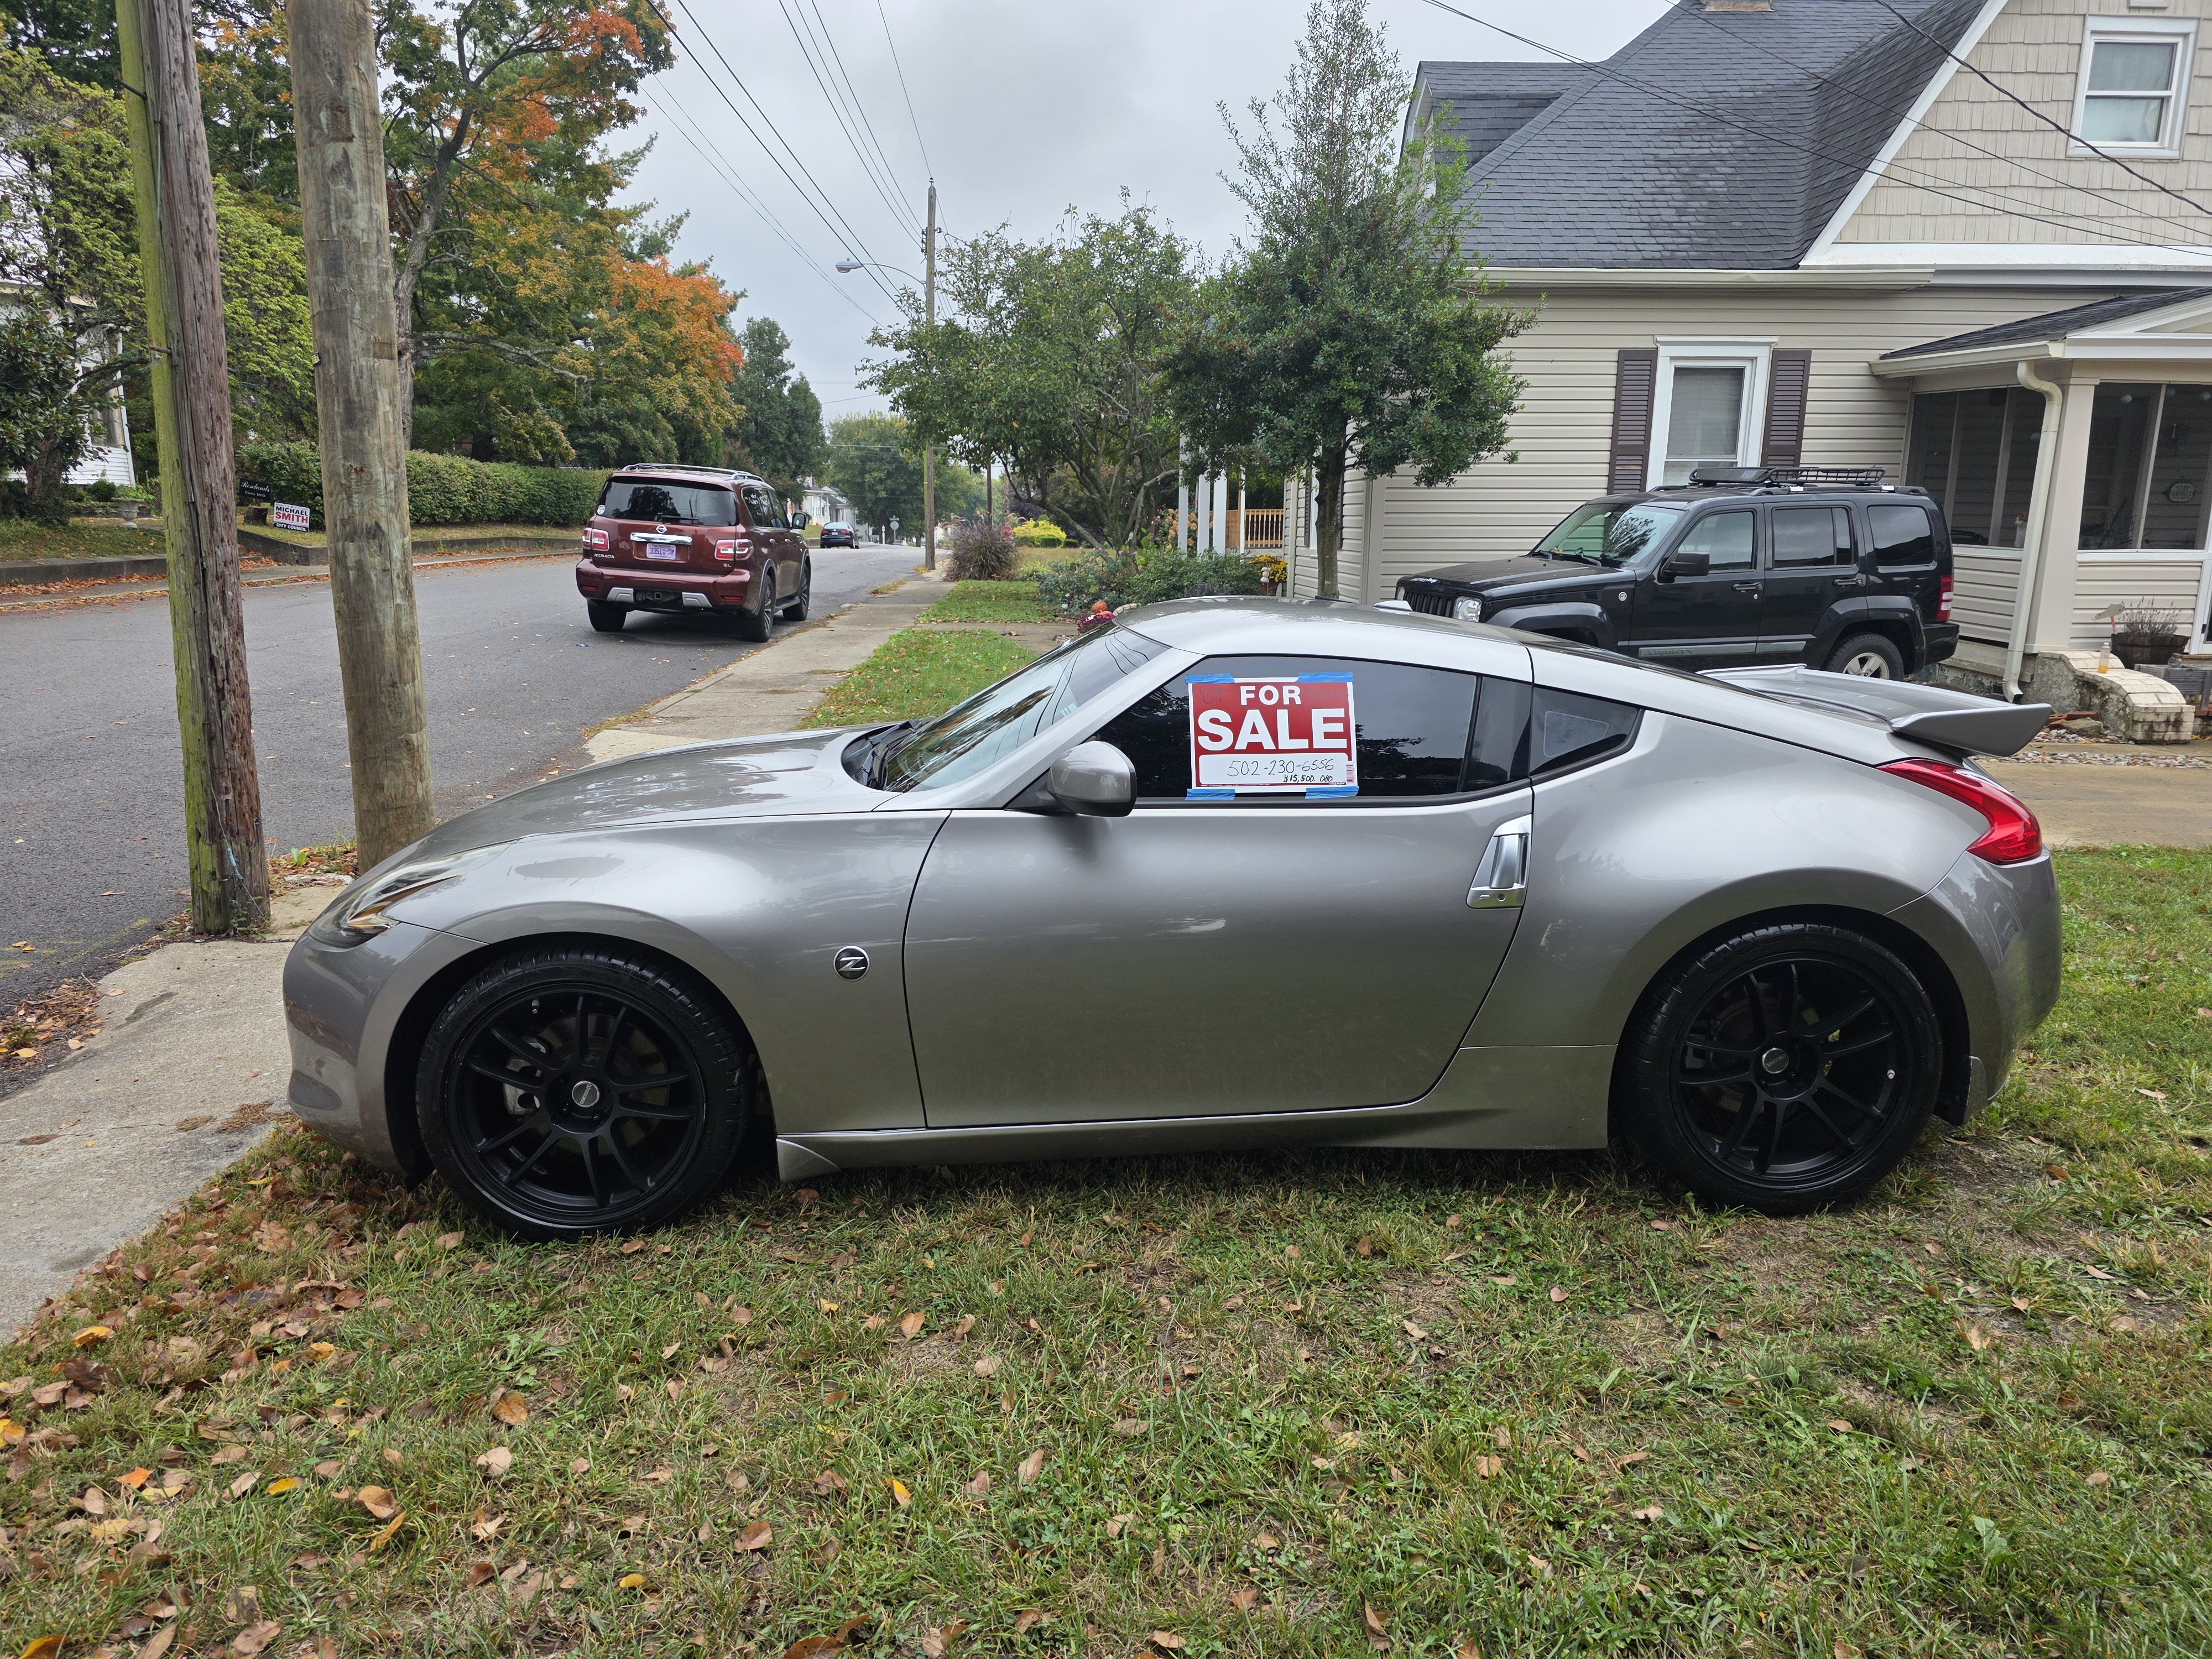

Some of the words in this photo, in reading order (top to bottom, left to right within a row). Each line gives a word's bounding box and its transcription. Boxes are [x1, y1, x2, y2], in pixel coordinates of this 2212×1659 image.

[275, 512, 308, 524] SMITH
[276, 506, 308, 516] MICHAEL
[1240, 685, 1301, 705] FOR
[1197, 708, 1347, 751] SALE
[1227, 759, 1334, 776] 502-230-6556
[838, 957, 866, 972] Z
